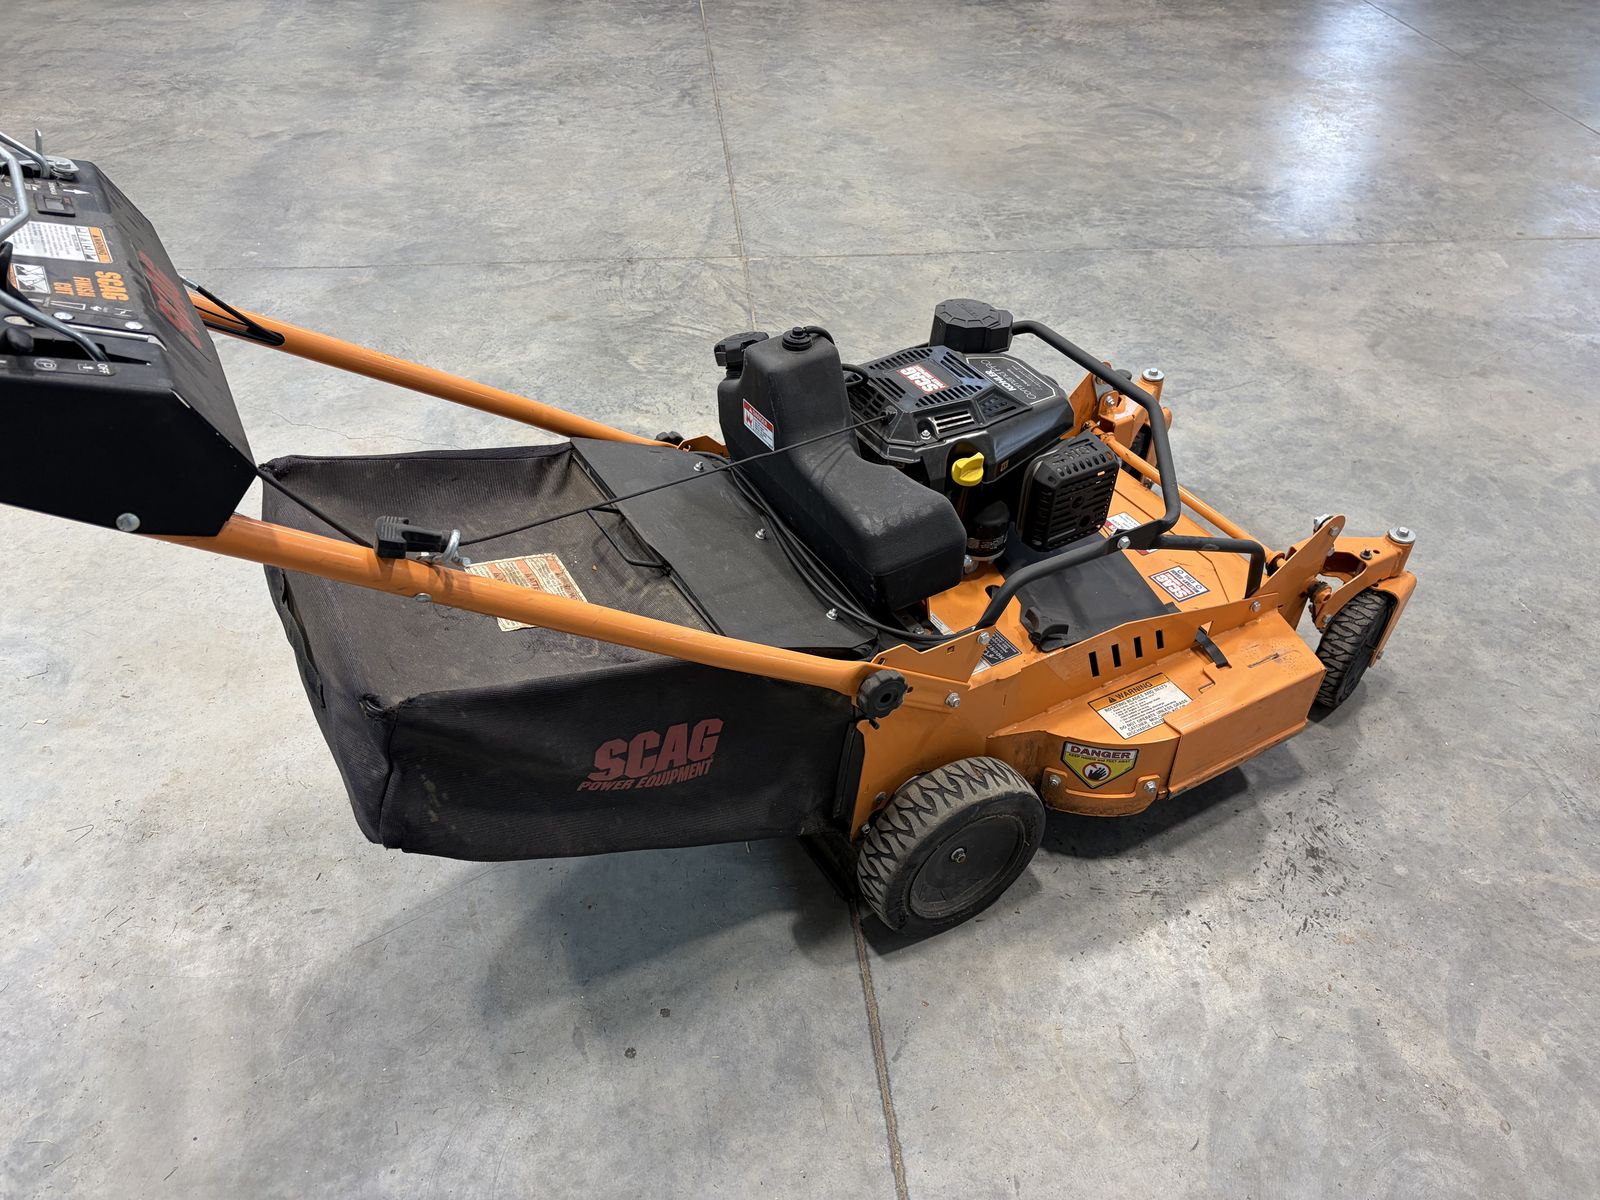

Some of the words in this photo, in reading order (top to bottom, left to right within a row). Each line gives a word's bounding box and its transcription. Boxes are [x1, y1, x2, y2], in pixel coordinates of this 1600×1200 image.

[53, 282, 74, 296] CUT
[73, 276, 96, 298] FINISH
[95, 270, 129, 301] SCAG
[97, 363, 110, 375] OFF
[900, 366, 939, 391] SCAG
[985, 369, 1017, 391] KOHLER
[1154, 574, 1189, 599] SCAG
[1115, 681, 1153, 700] WARNING
[1104, 699, 1127, 713] ROTATING
[1127, 693, 1144, 704] BLADES
[1136, 712, 1157, 724] OPERATE
[588, 718, 724, 782] SCAG
[1070, 745, 1131, 759] DANGER
[576, 779, 635, 792] POWER
[635, 758, 713, 789] EQUIPMENT
